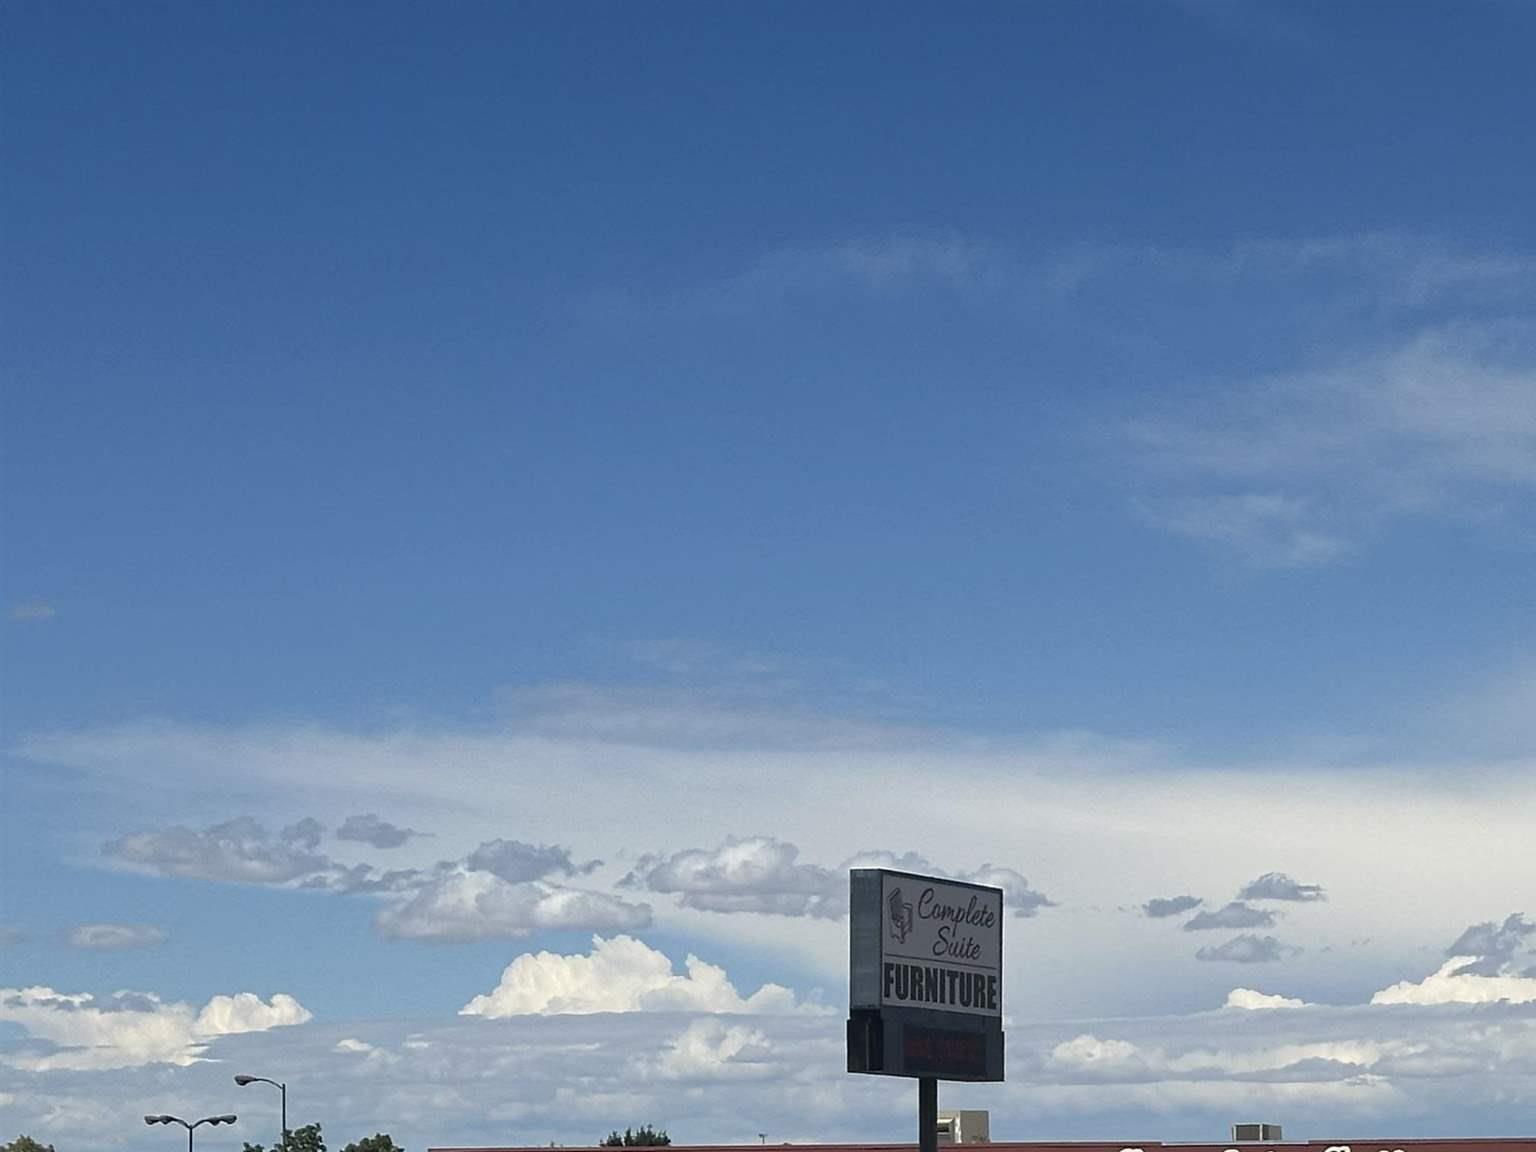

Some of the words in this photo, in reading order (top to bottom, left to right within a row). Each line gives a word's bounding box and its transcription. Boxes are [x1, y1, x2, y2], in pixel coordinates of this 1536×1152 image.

[917, 888, 996, 939] Complete
[932, 926, 982, 960] Suite
[884, 962, 997, 1010] FURNITURE
